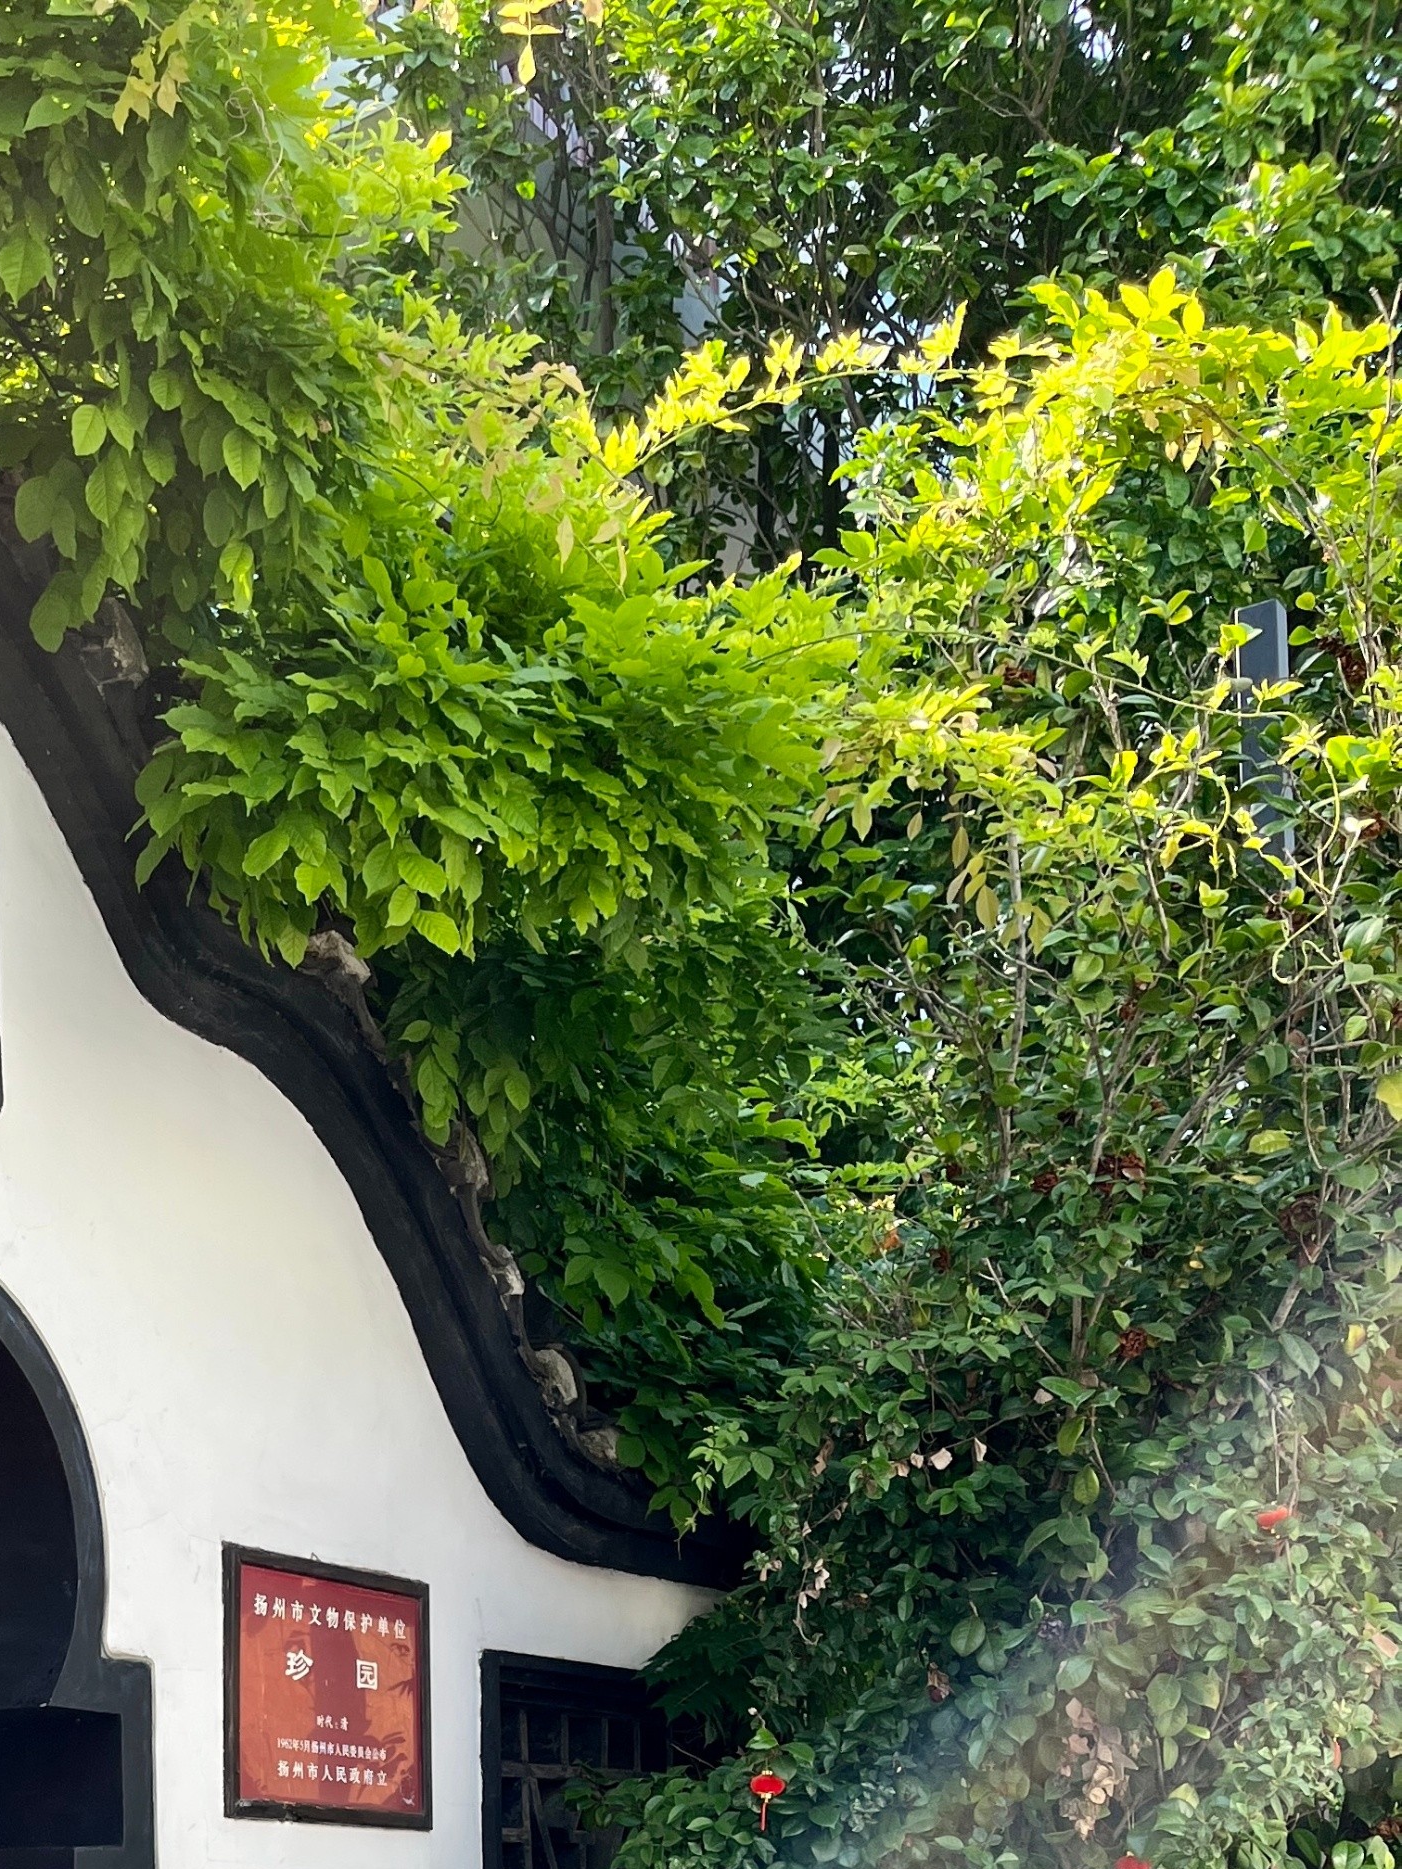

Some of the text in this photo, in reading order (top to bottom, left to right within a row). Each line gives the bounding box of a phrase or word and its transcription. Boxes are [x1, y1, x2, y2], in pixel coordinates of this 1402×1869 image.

[253, 1592, 407, 1640] 扬州市文物保护单位
[284, 1648, 379, 1691] 珍园
[277, 1759, 388, 1786] 扬州市人民政府立
